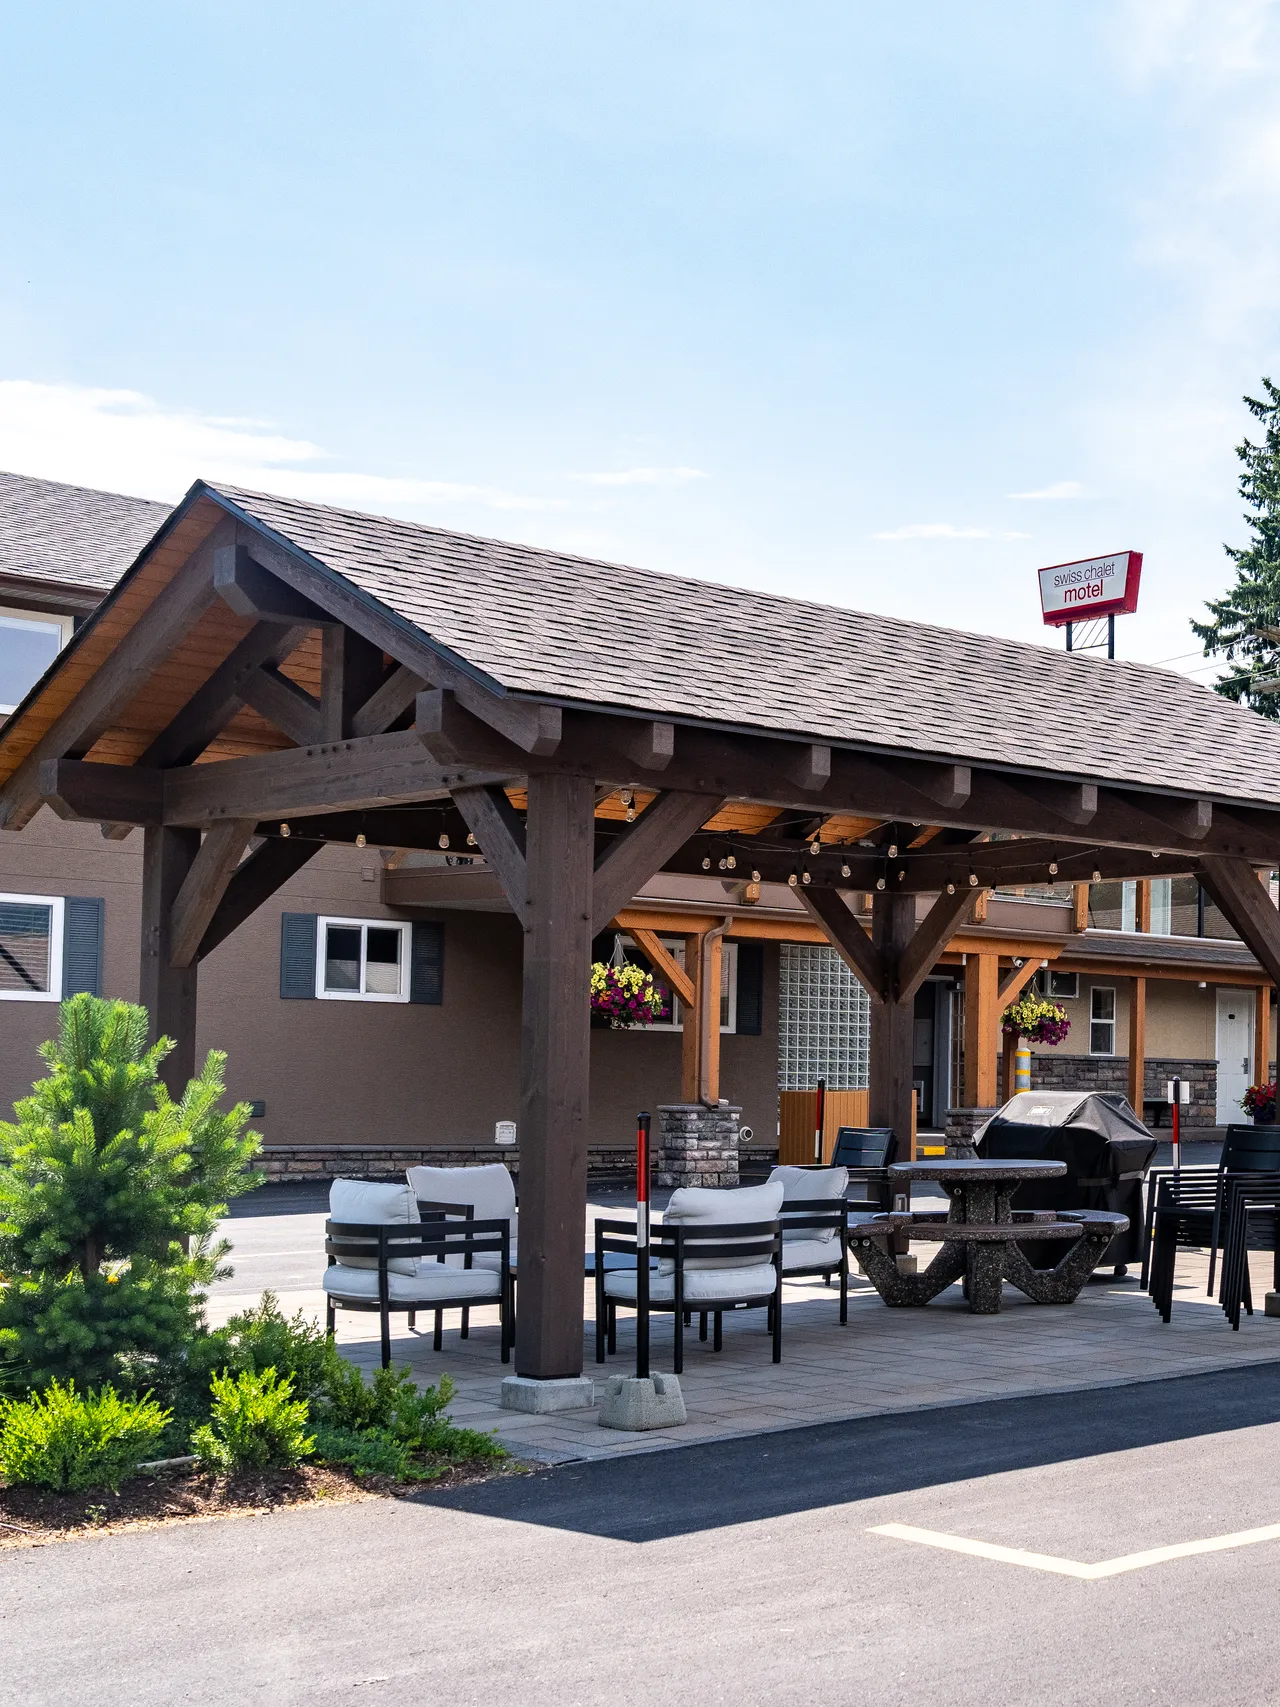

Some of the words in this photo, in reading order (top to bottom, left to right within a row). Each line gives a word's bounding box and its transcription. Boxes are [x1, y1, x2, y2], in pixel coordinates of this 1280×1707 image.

[1054, 570, 1082, 587] swiss
[1084, 562, 1115, 580] chalet
[1064, 579, 1103, 603] motel
